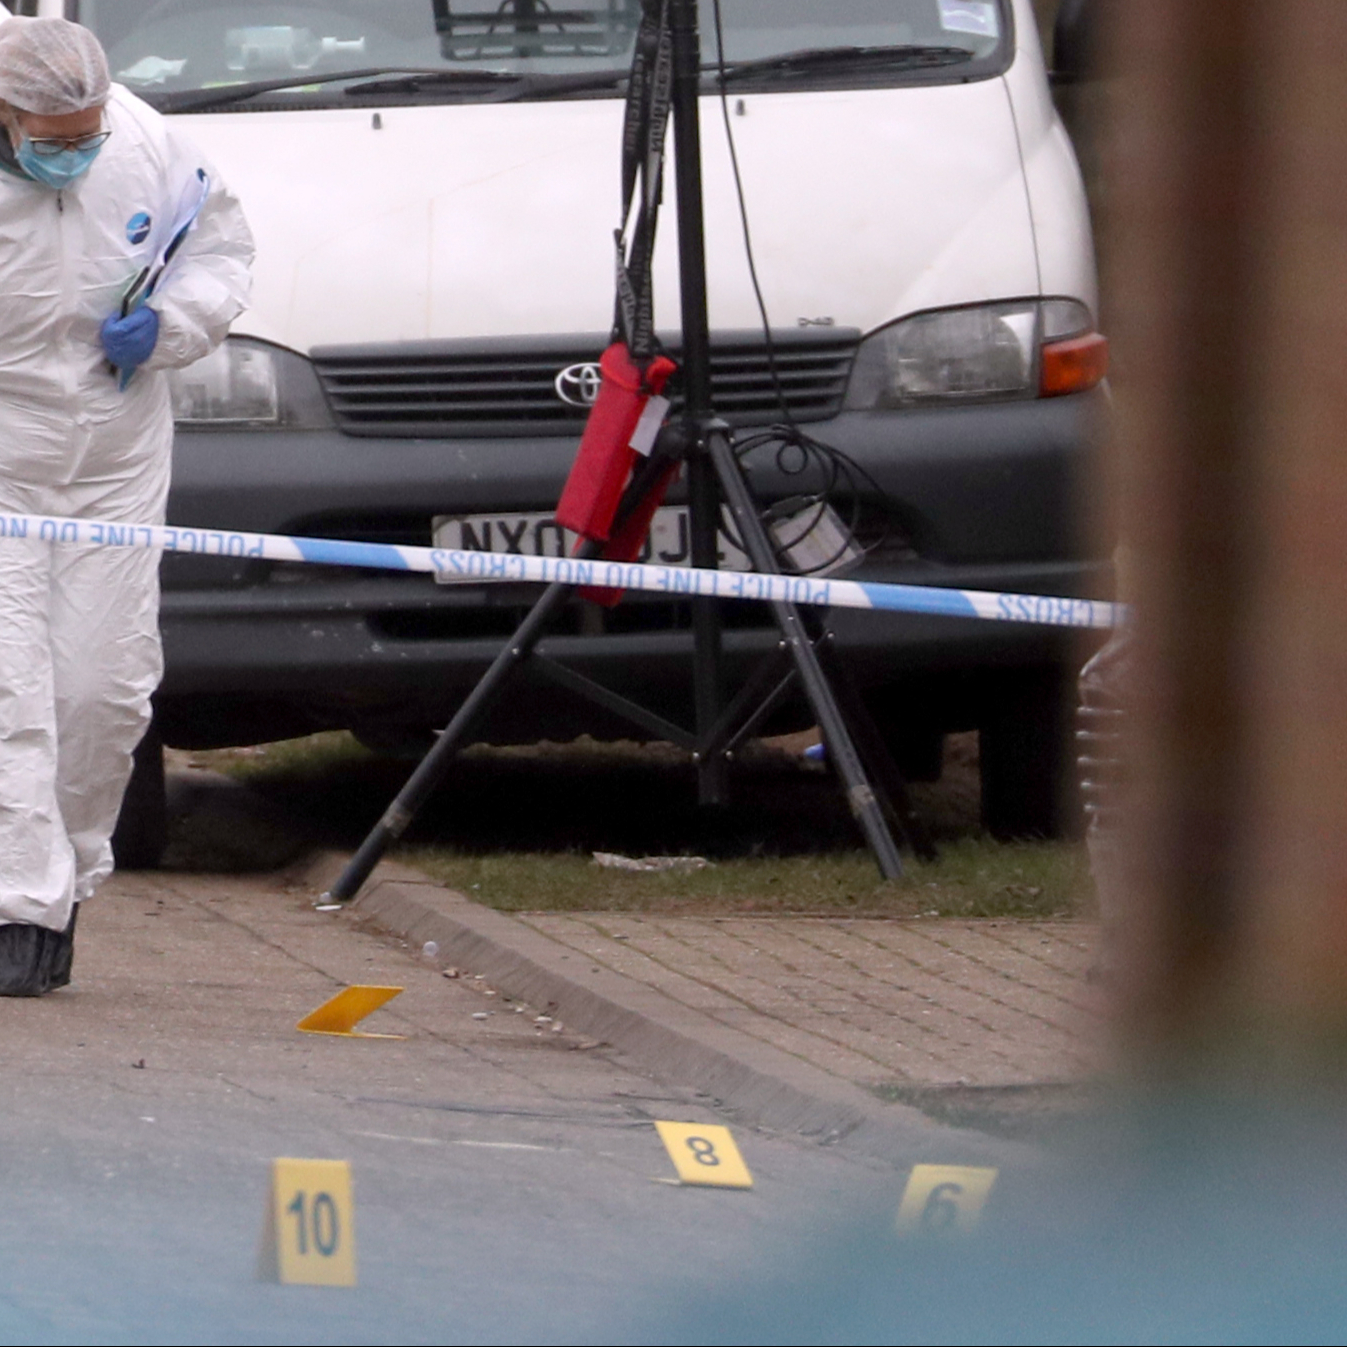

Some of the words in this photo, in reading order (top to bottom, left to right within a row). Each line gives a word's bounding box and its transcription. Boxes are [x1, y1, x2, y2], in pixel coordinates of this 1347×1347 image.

[39, 518, 79, 543] DO
[89, 523, 152, 548] LINE
[163, 529, 265, 559] POLICE
[429, 549, 527, 579] CROSS
[541, 559, 594, 585] NOT
[606, 564, 645, 588] DO
[656, 568, 717, 595] LINE
[730, 574, 831, 605] POLICE
[996, 594, 1095, 626] CROSS
[684, 1136, 721, 1167] 8
[287, 1190, 340, 1258] 10
[922, 1181, 963, 1237] 6
